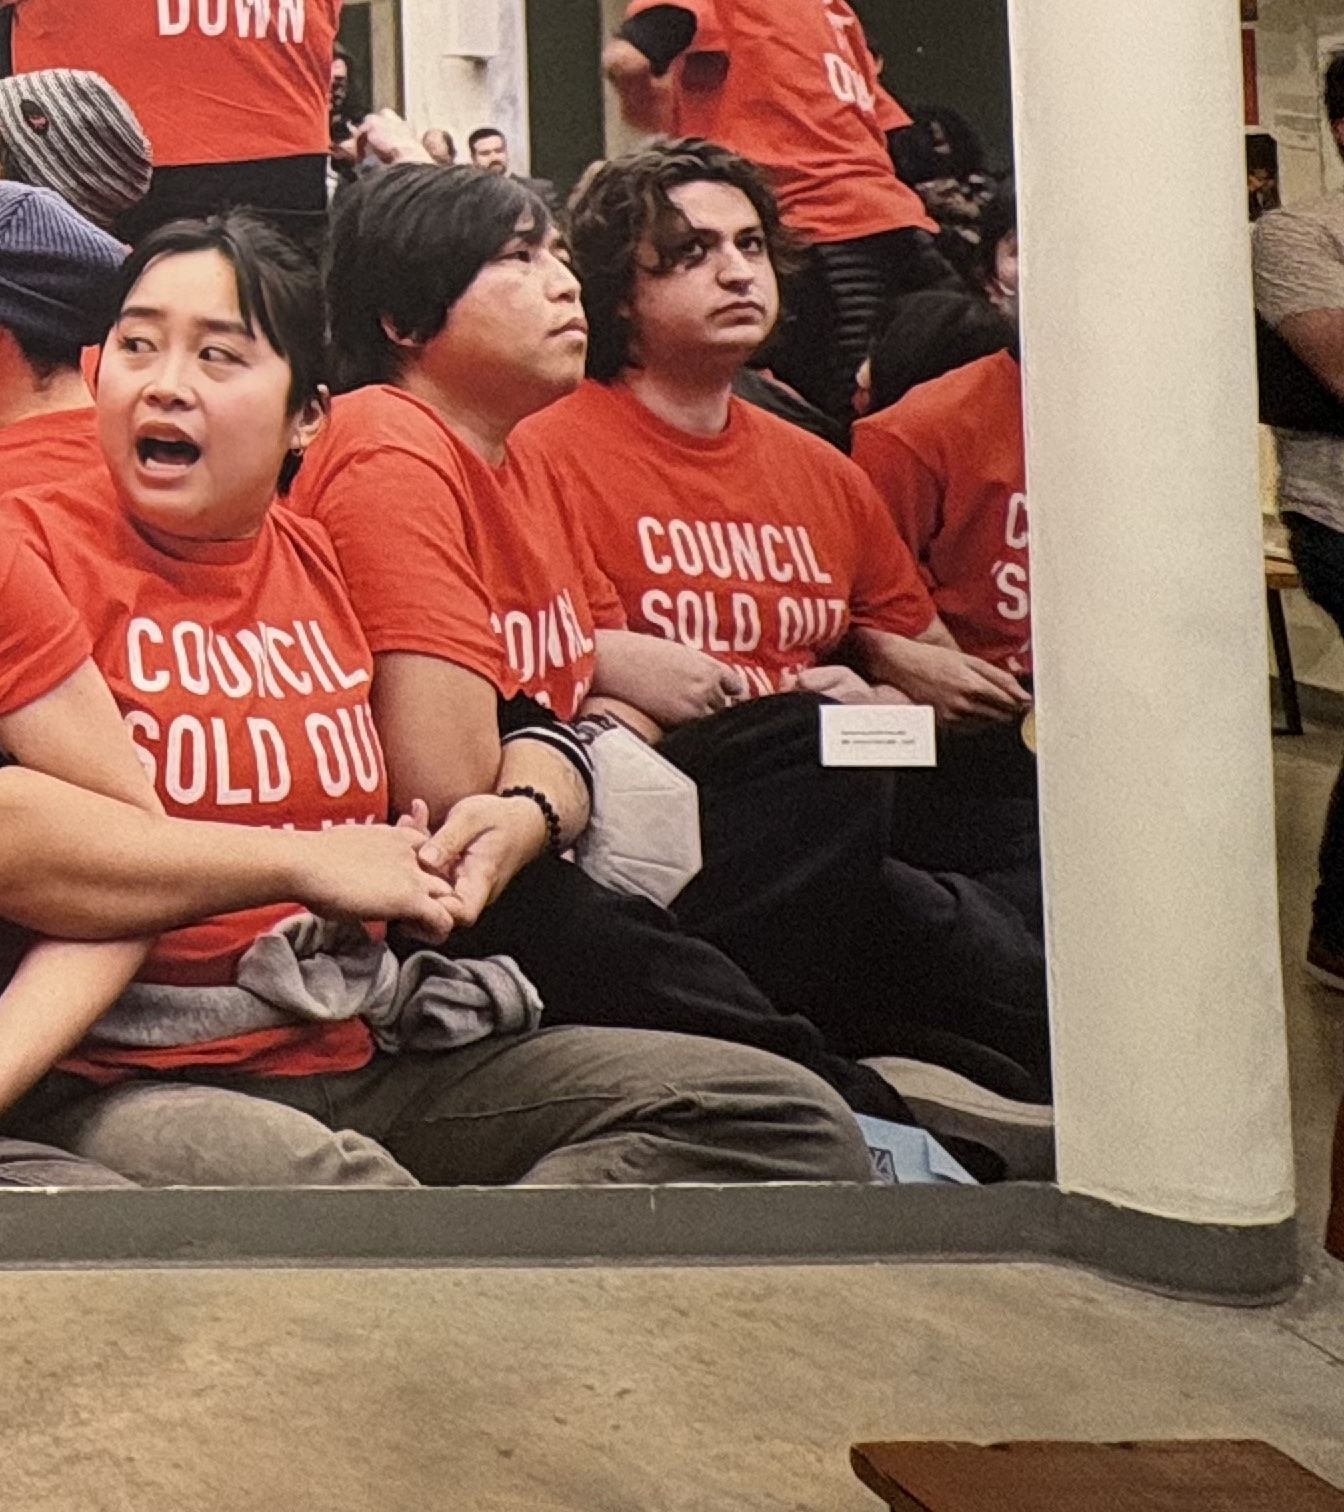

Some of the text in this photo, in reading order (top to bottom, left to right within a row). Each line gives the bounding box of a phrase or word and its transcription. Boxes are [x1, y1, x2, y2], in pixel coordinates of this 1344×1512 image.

[637, 516, 832, 584] COUNCIL
[641, 589, 761, 652] SOLD
[778, 595, 846, 652] OUT
[125, 617, 369, 701] COUNCIL
[305, 704, 387, 798] OU
